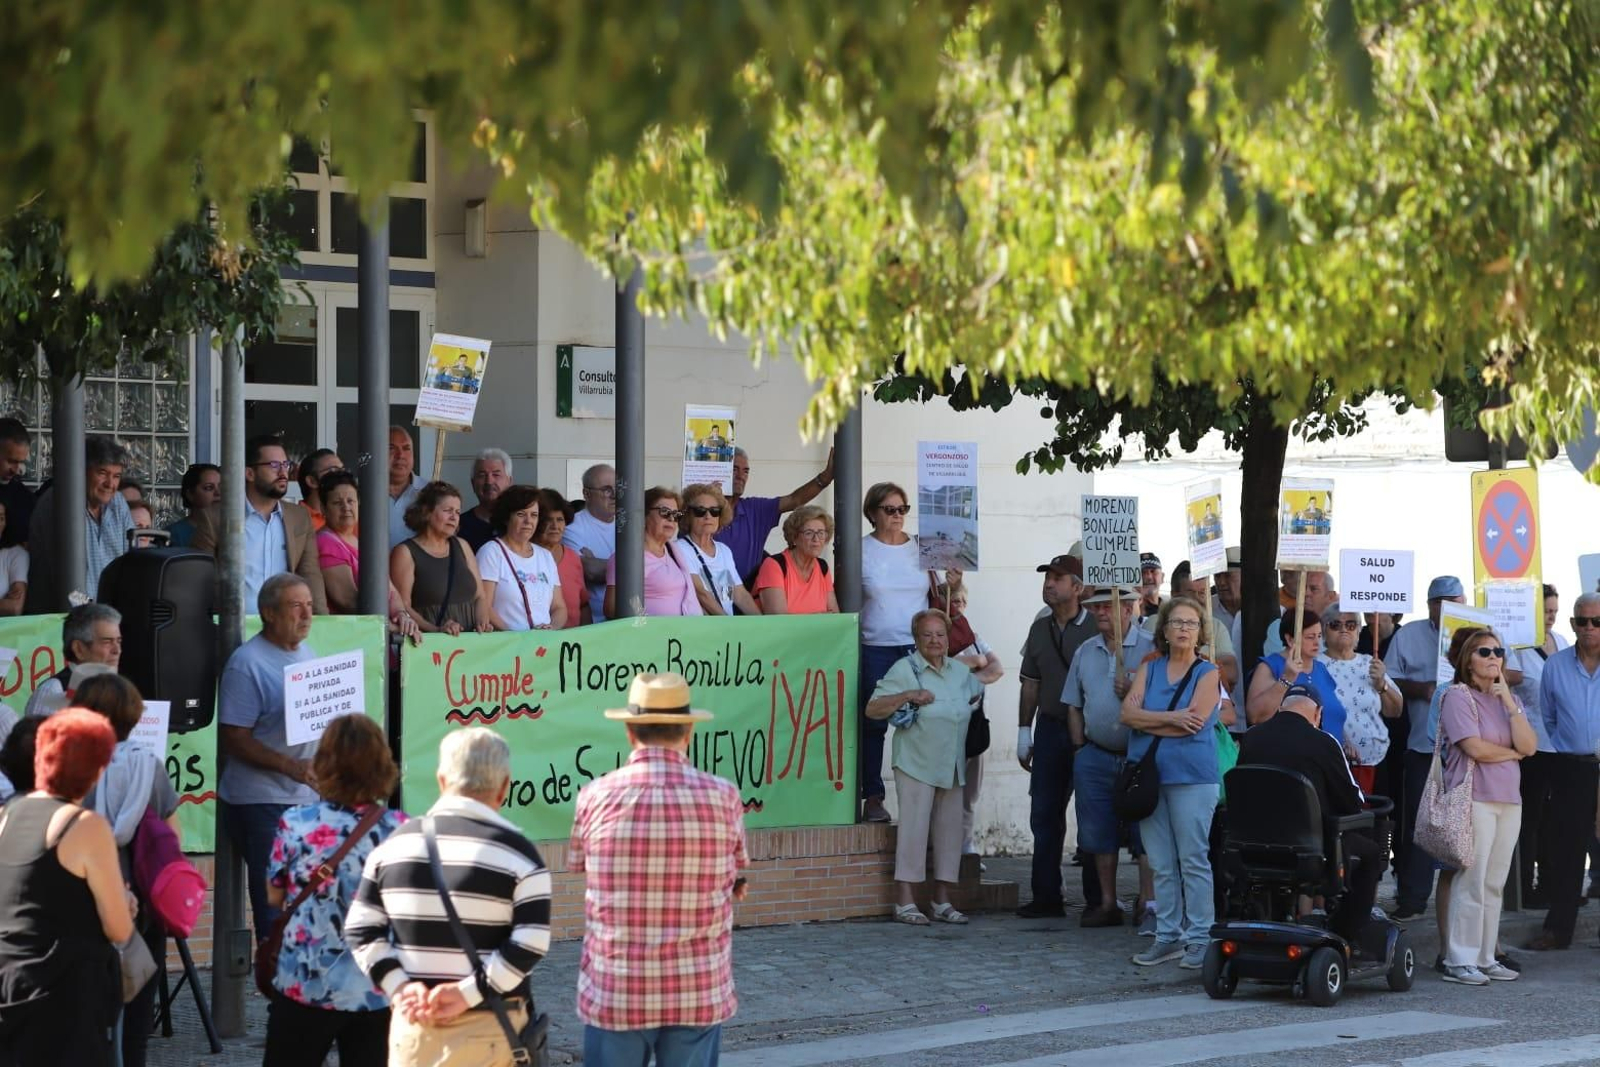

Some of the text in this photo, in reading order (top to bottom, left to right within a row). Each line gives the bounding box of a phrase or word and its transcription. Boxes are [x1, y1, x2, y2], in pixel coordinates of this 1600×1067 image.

[579, 385, 613, 395] Villarrubia
[1085, 498, 1136, 514] MORENO
[1083, 517, 1137, 534] BONILLA
[1085, 535, 1138, 552] CUMPLE
[1102, 552, 1117, 566] LO
[1360, 557, 1395, 568] SALUD
[1088, 565, 1141, 584] PROMETIDO
[1369, 573, 1385, 584] NO
[1350, 591, 1407, 602] RESPONDE
[291, 660, 357, 681] NO A LA SANIDAD
[667, 638, 764, 688] Bonilla
[308, 677, 341, 691] PRIVADA
[304, 698, 310, 706] A
[311, 695, 321, 705] LA
[323, 687, 356, 701] SANIDAD
[300, 701, 352, 720] PUBLICA Y DE
[542, 763, 572, 804] de
